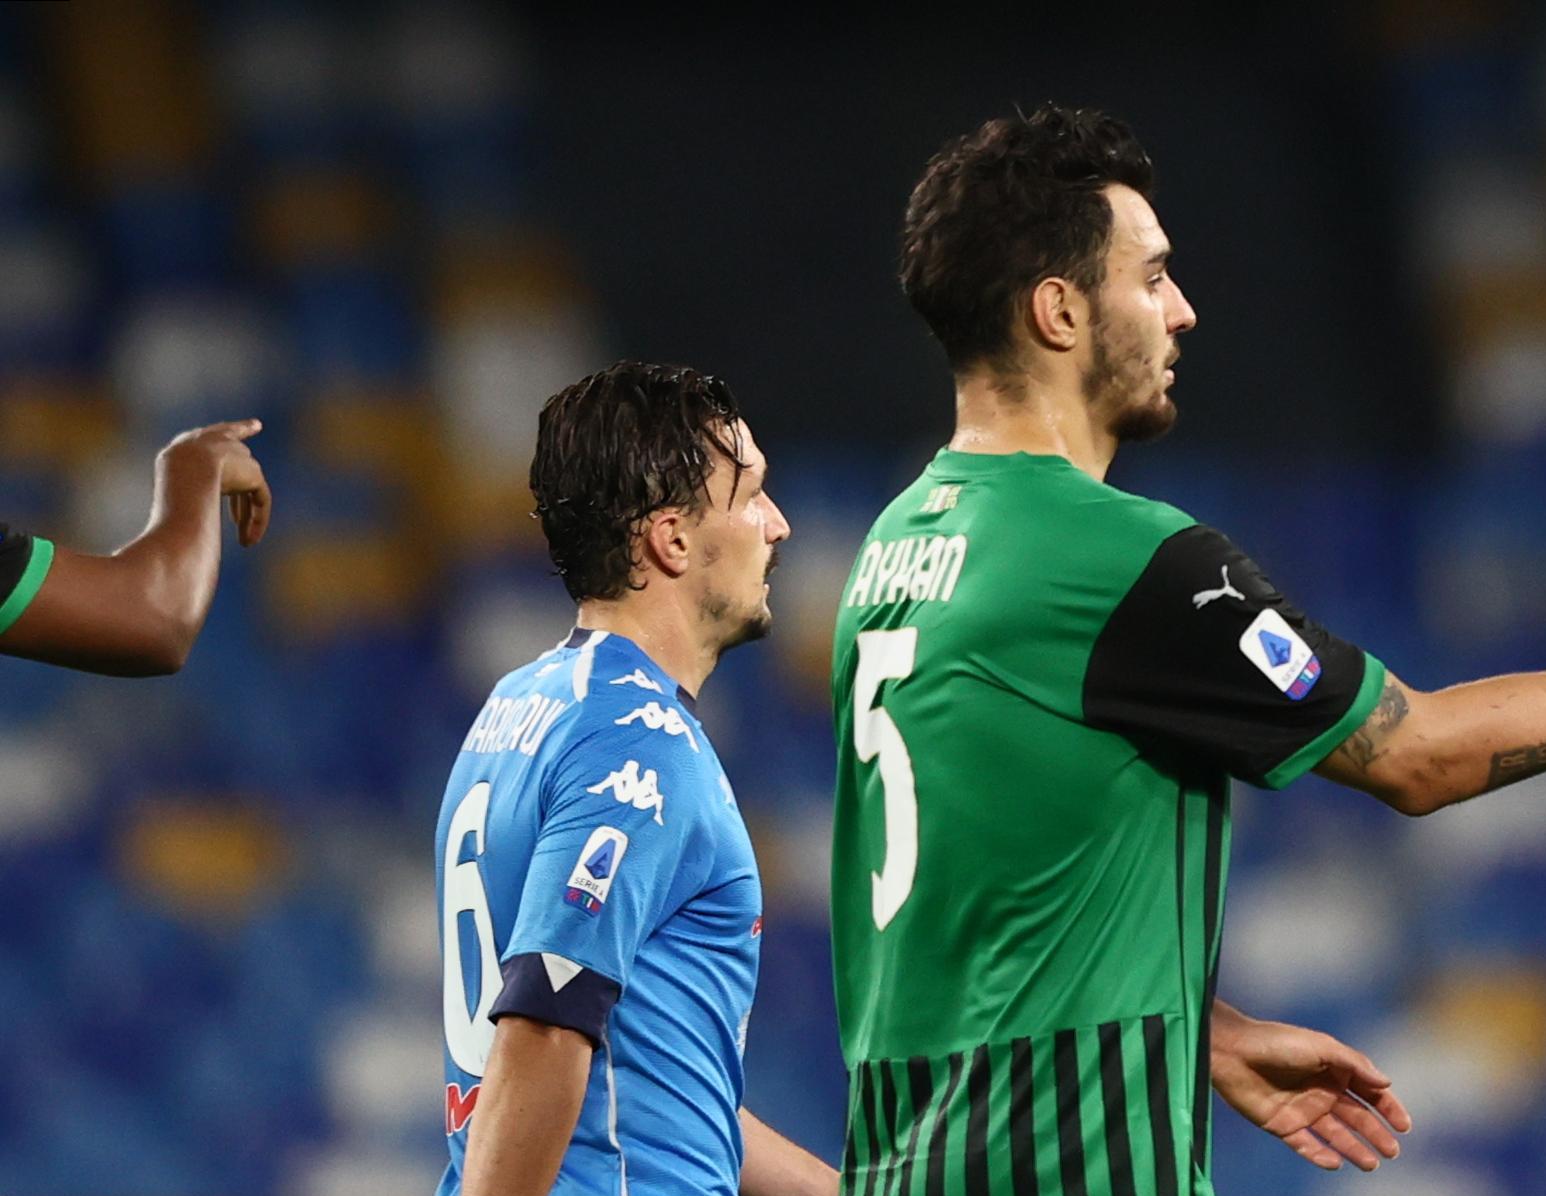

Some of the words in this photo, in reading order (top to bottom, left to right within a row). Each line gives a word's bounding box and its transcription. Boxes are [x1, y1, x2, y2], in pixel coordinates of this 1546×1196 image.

[847, 534, 967, 608] AYHAN
[853, 627, 918, 932] 5
[443, 780, 504, 1078] 6
